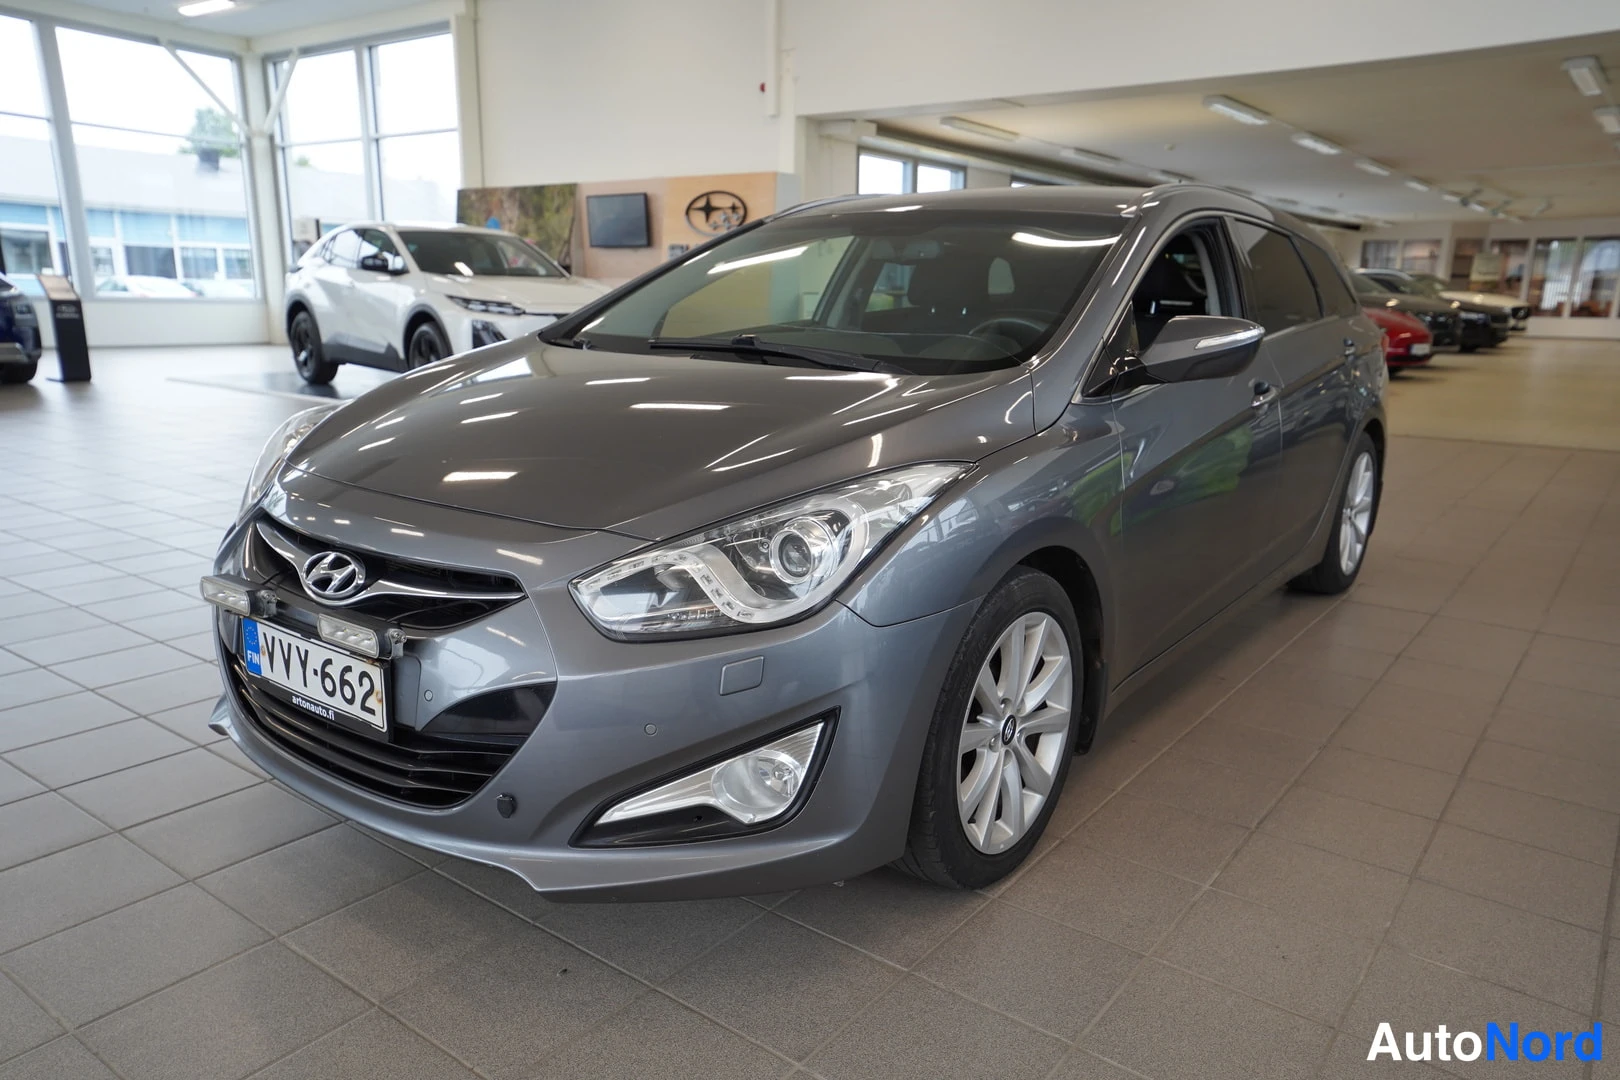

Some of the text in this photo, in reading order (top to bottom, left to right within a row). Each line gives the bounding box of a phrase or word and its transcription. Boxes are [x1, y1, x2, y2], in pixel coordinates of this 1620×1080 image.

[247, 650, 260, 666] FIN
[263, 632, 376, 716] VVY-662
[291, 695, 335, 721] artonauto.fi
